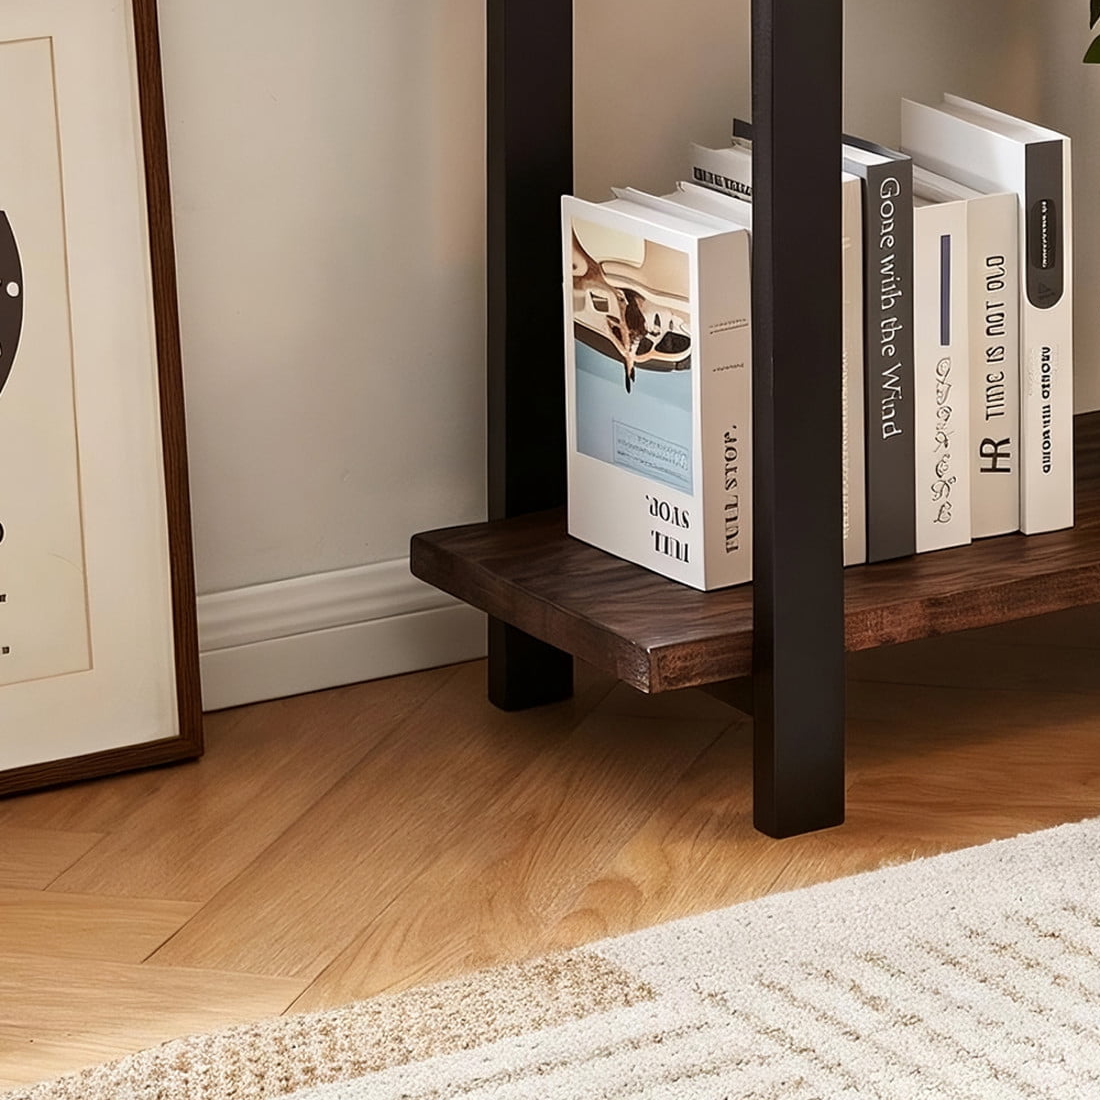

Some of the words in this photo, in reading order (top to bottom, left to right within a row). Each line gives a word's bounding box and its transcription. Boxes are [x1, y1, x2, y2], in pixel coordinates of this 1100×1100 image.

[879, 177, 901, 249] Gone
[880, 317, 902, 357] the
[985, 346, 1005, 363] IS
[880, 363, 902, 440] Wind
